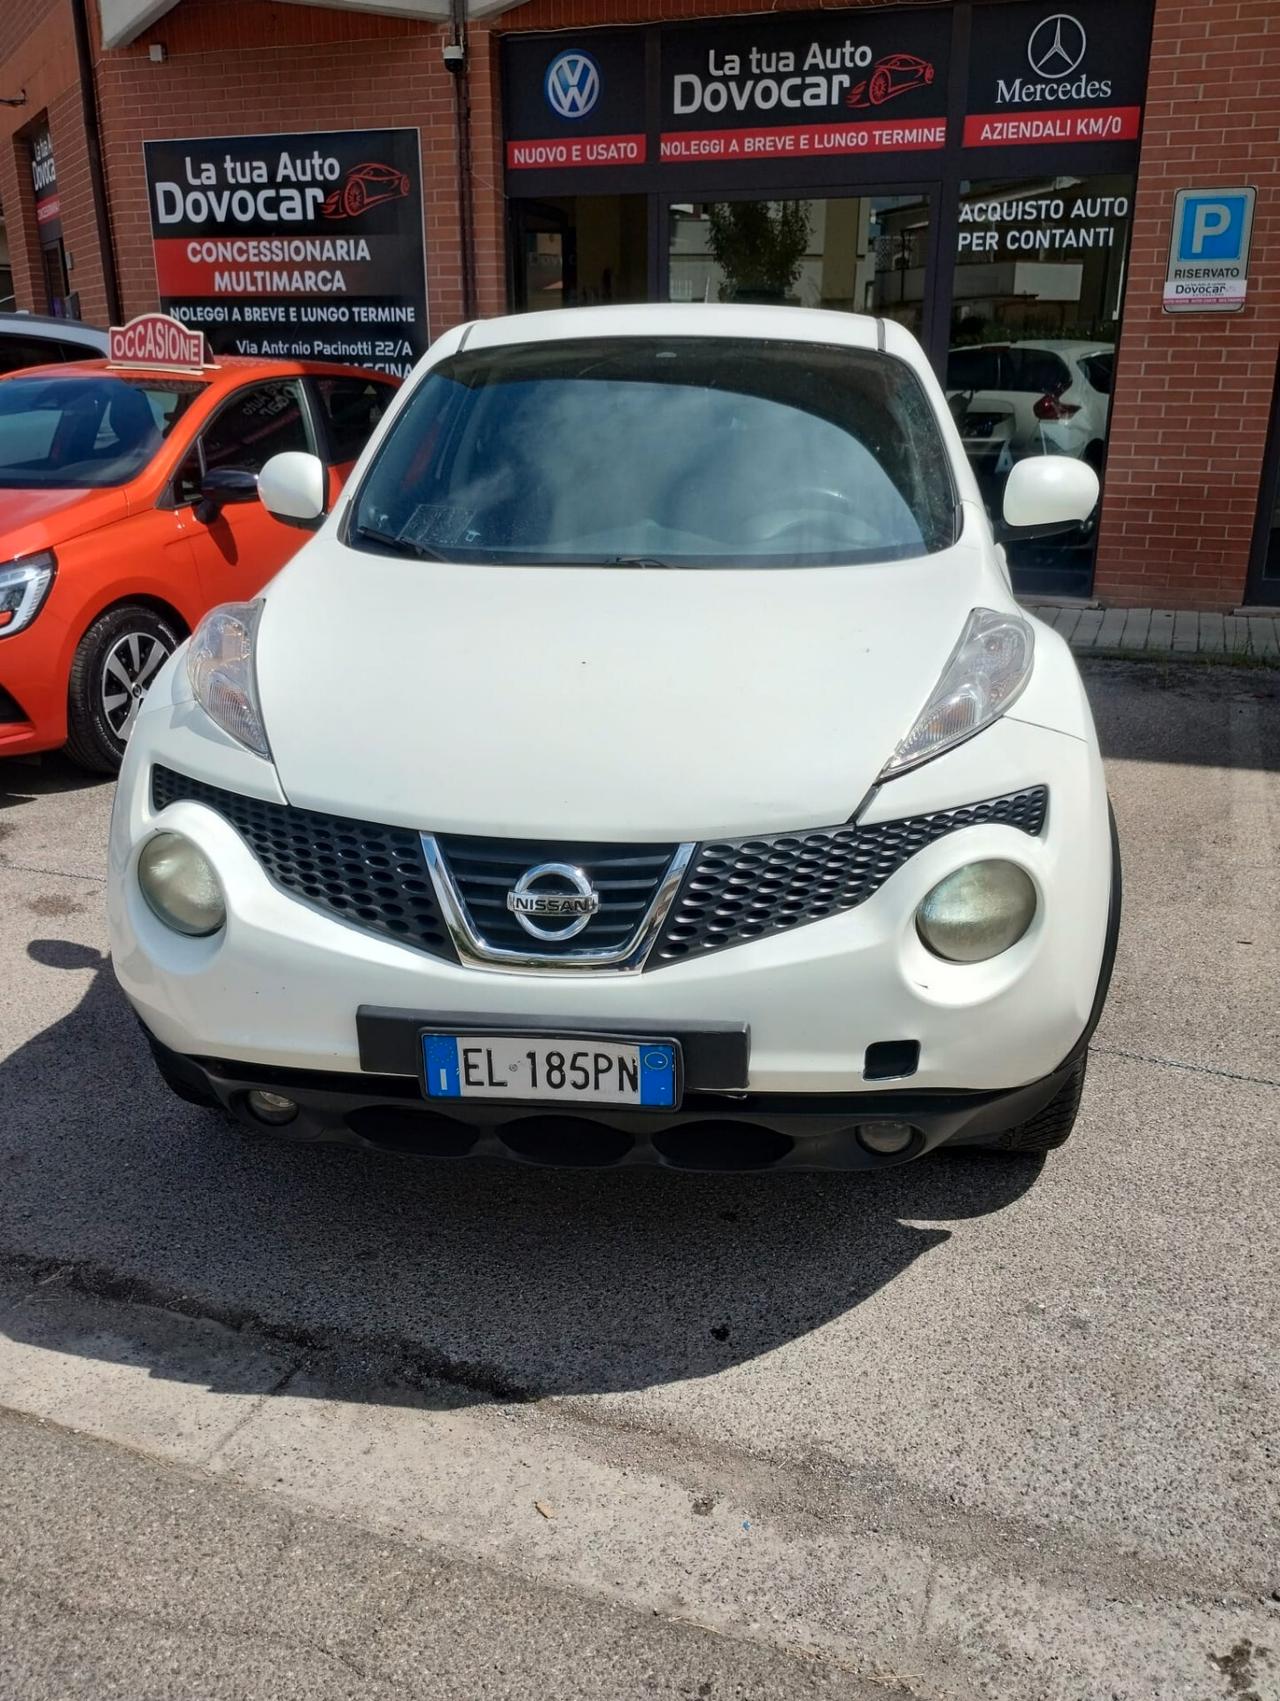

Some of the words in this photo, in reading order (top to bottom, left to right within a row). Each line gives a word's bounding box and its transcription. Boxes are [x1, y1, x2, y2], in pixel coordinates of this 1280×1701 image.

[708, 50, 741, 76] La
[749, 47, 795, 73] tua
[803, 40, 872, 71] Auto
[673, 73, 851, 115] Dovocar
[995, 74, 1112, 104] Mercedes
[660, 138, 725, 156] NOLEGGI
[728, 139, 739, 152] A
[744, 136, 795, 151] BREVE
[799, 134, 810, 148] E
[814, 132, 868, 148] LUNGO
[873, 127, 946, 145] TERMINE
[980, 119, 1071, 140] AZIENDALI
[513, 145, 566, 164] NUOVO
[572, 145, 581, 161] E
[586, 142, 638, 160] USATO
[32, 158, 56, 191] Dovoca
[185, 156, 217, 185] La
[224, 155, 268, 184] tua
[276, 151, 341, 182] Auto
[155, 181, 326, 224] Dovocar
[958, 201, 1064, 223] ACQUISTO
[1070, 197, 1129, 217] AUTO
[957, 231, 999, 251] PER
[1005, 228, 1115, 250] CONTANTI
[1191, 203, 1232, 254] P
[187, 239, 371, 263] CONCESSIONARIA
[214, 270, 347, 292] MULTIMARCA
[1174, 267, 1240, 279] RISERVATO
[1175, 284, 1226, 295] Dovocar
[169, 306, 229, 322] NOLEGGI
[231, 306, 241, 322] A
[244, 306, 286, 322] BREVE
[289, 306, 298, 322] E
[300, 306, 349, 322] LUNGO
[352, 306, 416, 322] TERMINE
[113, 321, 200, 362] OCCASIONE
[236, 340, 258, 355] Via
[313, 340, 372, 356] Pacinotti
[375, 340, 413, 358] 22/A
[514, 897, 588, 912] NISSAN
[463, 1048, 508, 1087] EL
[526, 1051, 639, 1093] 185PN
